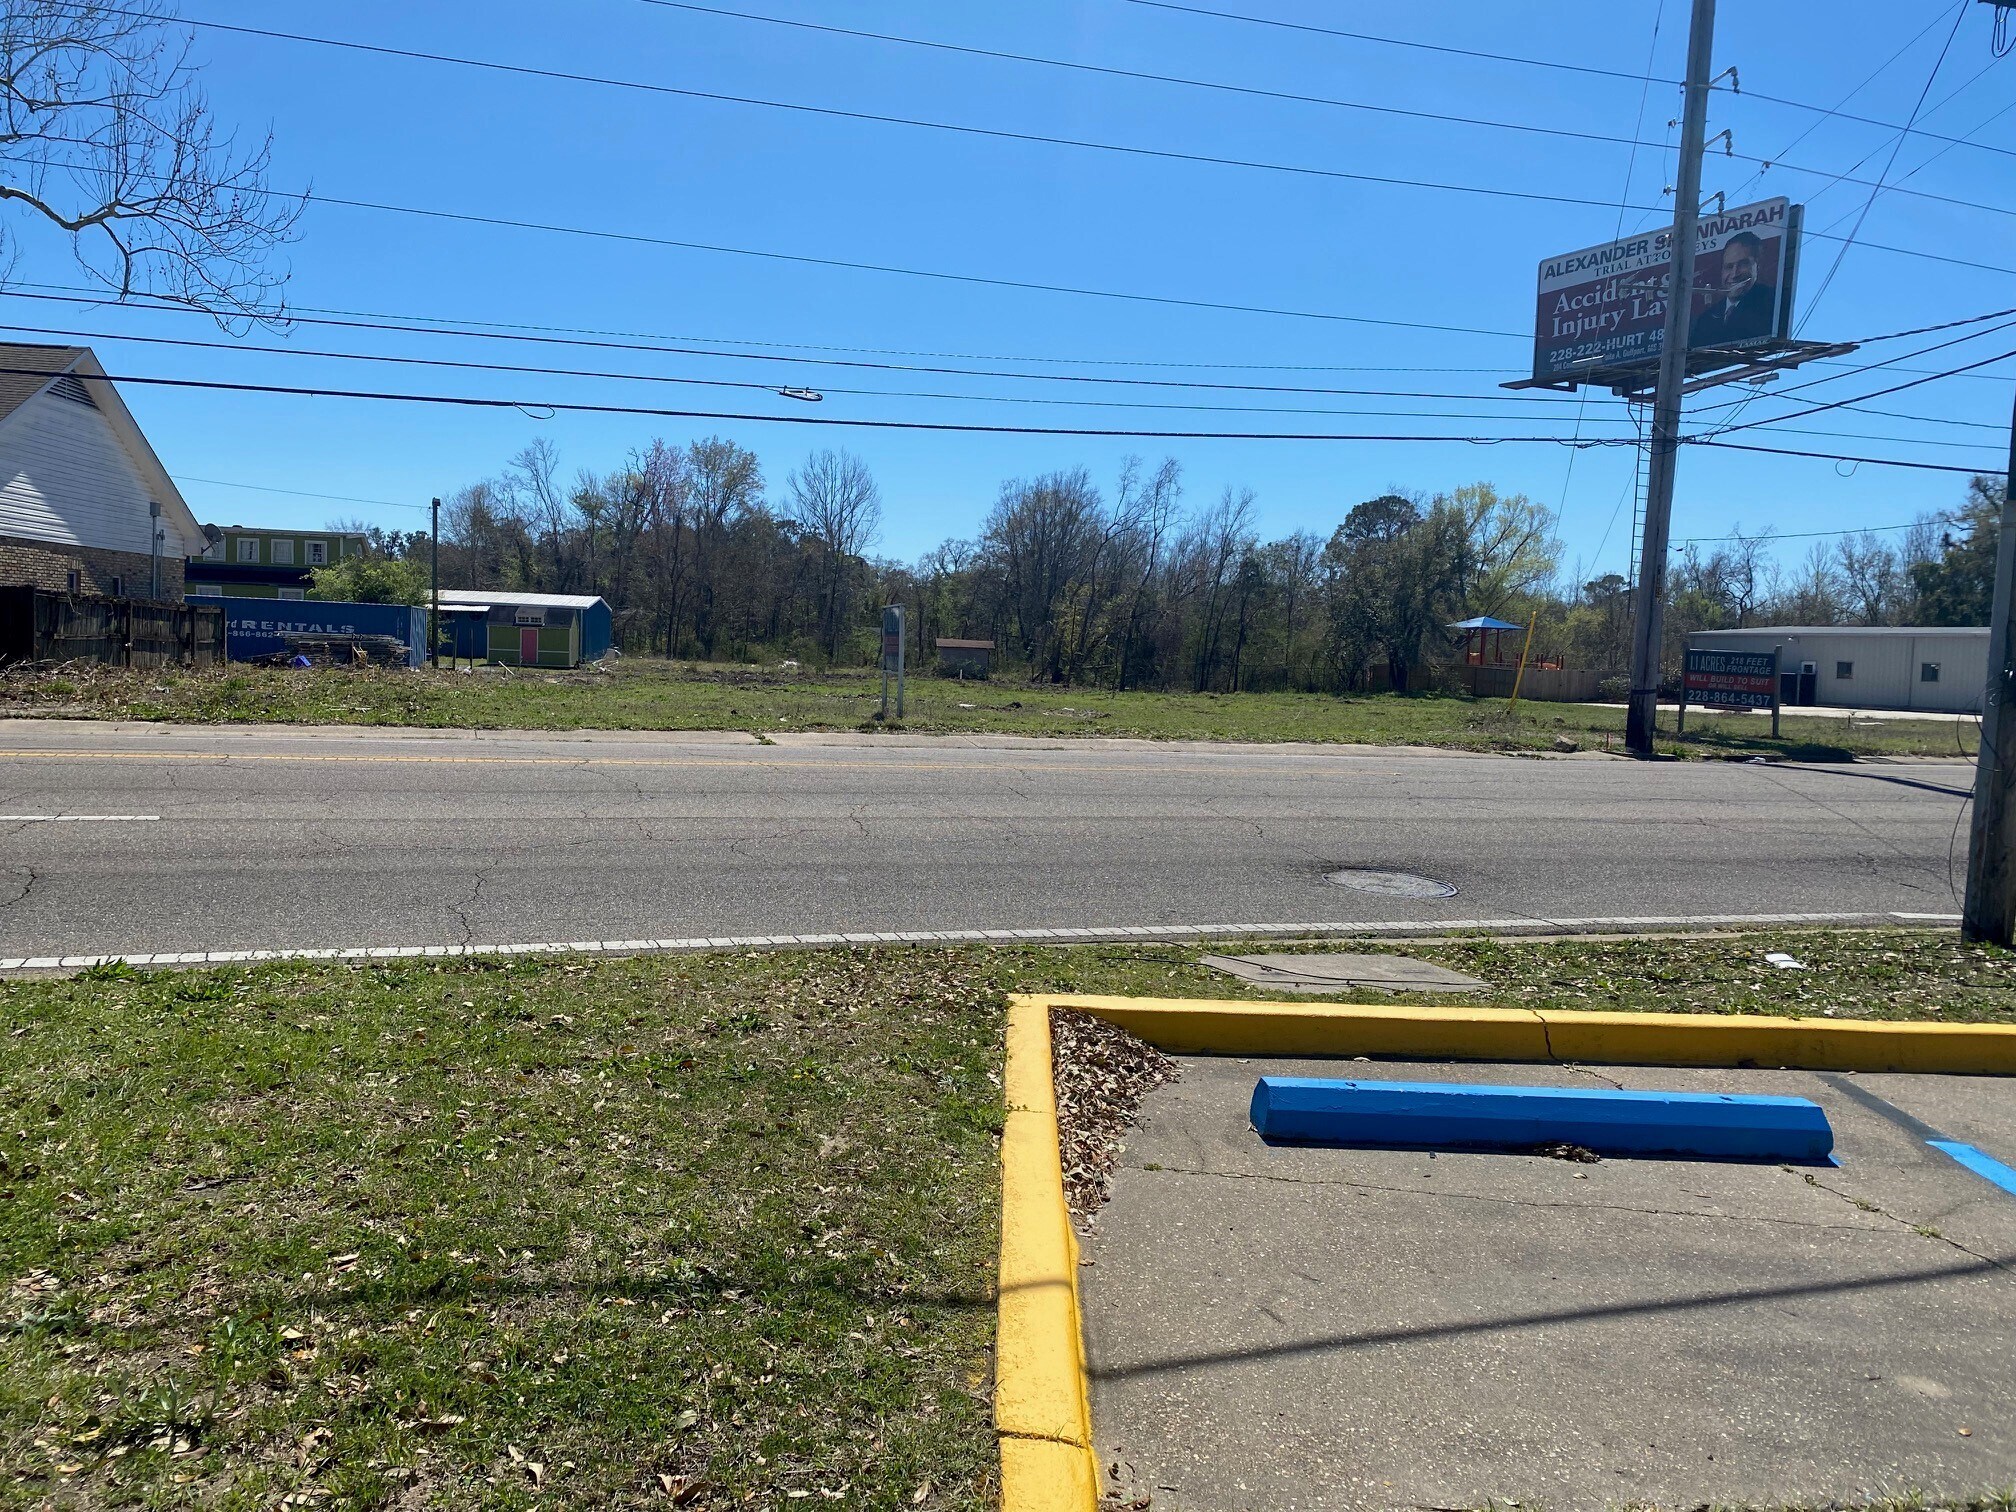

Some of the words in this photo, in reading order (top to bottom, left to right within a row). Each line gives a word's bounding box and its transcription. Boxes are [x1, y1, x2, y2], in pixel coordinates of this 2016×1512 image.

[1544, 239, 1648, 280] ALEXANDER
[1655, 204, 1784, 250] SNNARAH
[1594, 260, 1632, 277] TRIAL
[1637, 238, 1717, 266] ATTOEYS
[1552, 308, 1626, 339] Injury
[1549, 332, 1645, 363] 228-222-HURT
[241, 620, 355, 633] RENTALS
[1700, 655, 1726, 672] ACRES
[1726, 665, 1772, 675] FRONTAGE
[1746, 657, 1769, 666] FEET
[1690, 674, 1708, 682] WILL
[1711, 675, 1735, 684] BUILD
[1737, 677, 1748, 685] TO
[1750, 677, 1770, 686] SUIT
[1688, 689, 1771, 706] 228-864-5437
